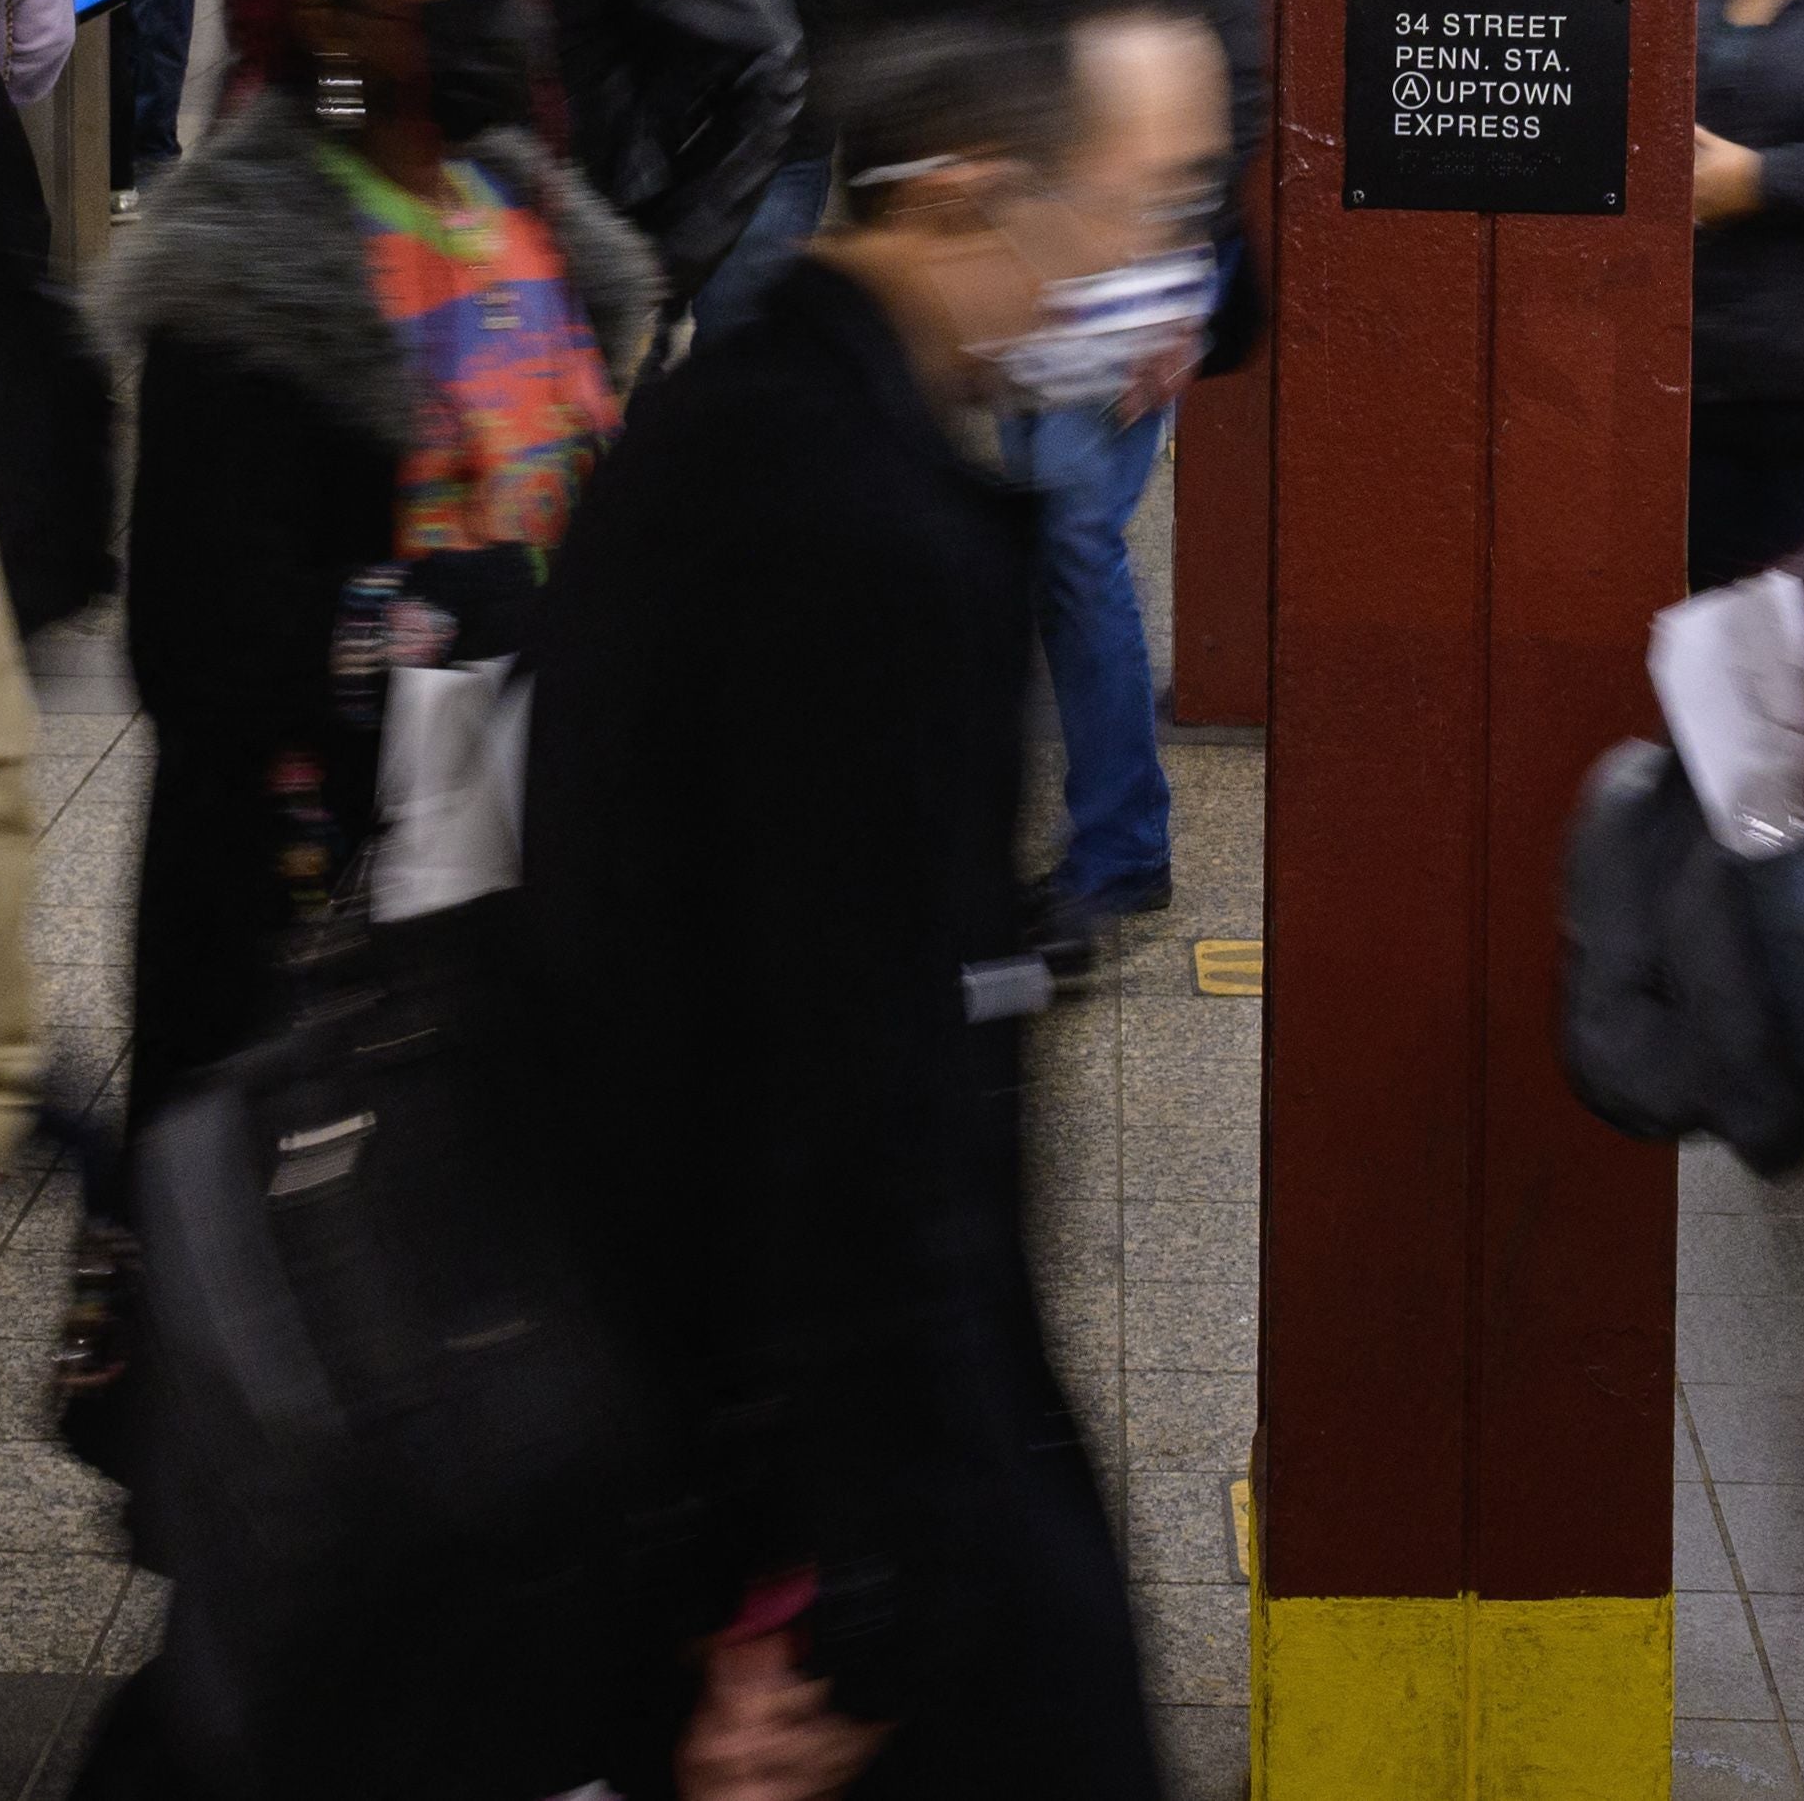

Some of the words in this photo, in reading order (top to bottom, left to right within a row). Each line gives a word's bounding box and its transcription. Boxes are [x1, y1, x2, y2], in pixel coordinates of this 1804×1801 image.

[1395, 12, 1430, 36] 34
[1443, 13, 1568, 39] STREET
[1395, 45, 1490, 71] PENN.
[1503, 48, 1571, 72] STA.
[1436, 80, 1572, 107] UPTOWN
[1394, 112, 1541, 140] EXPRESS
